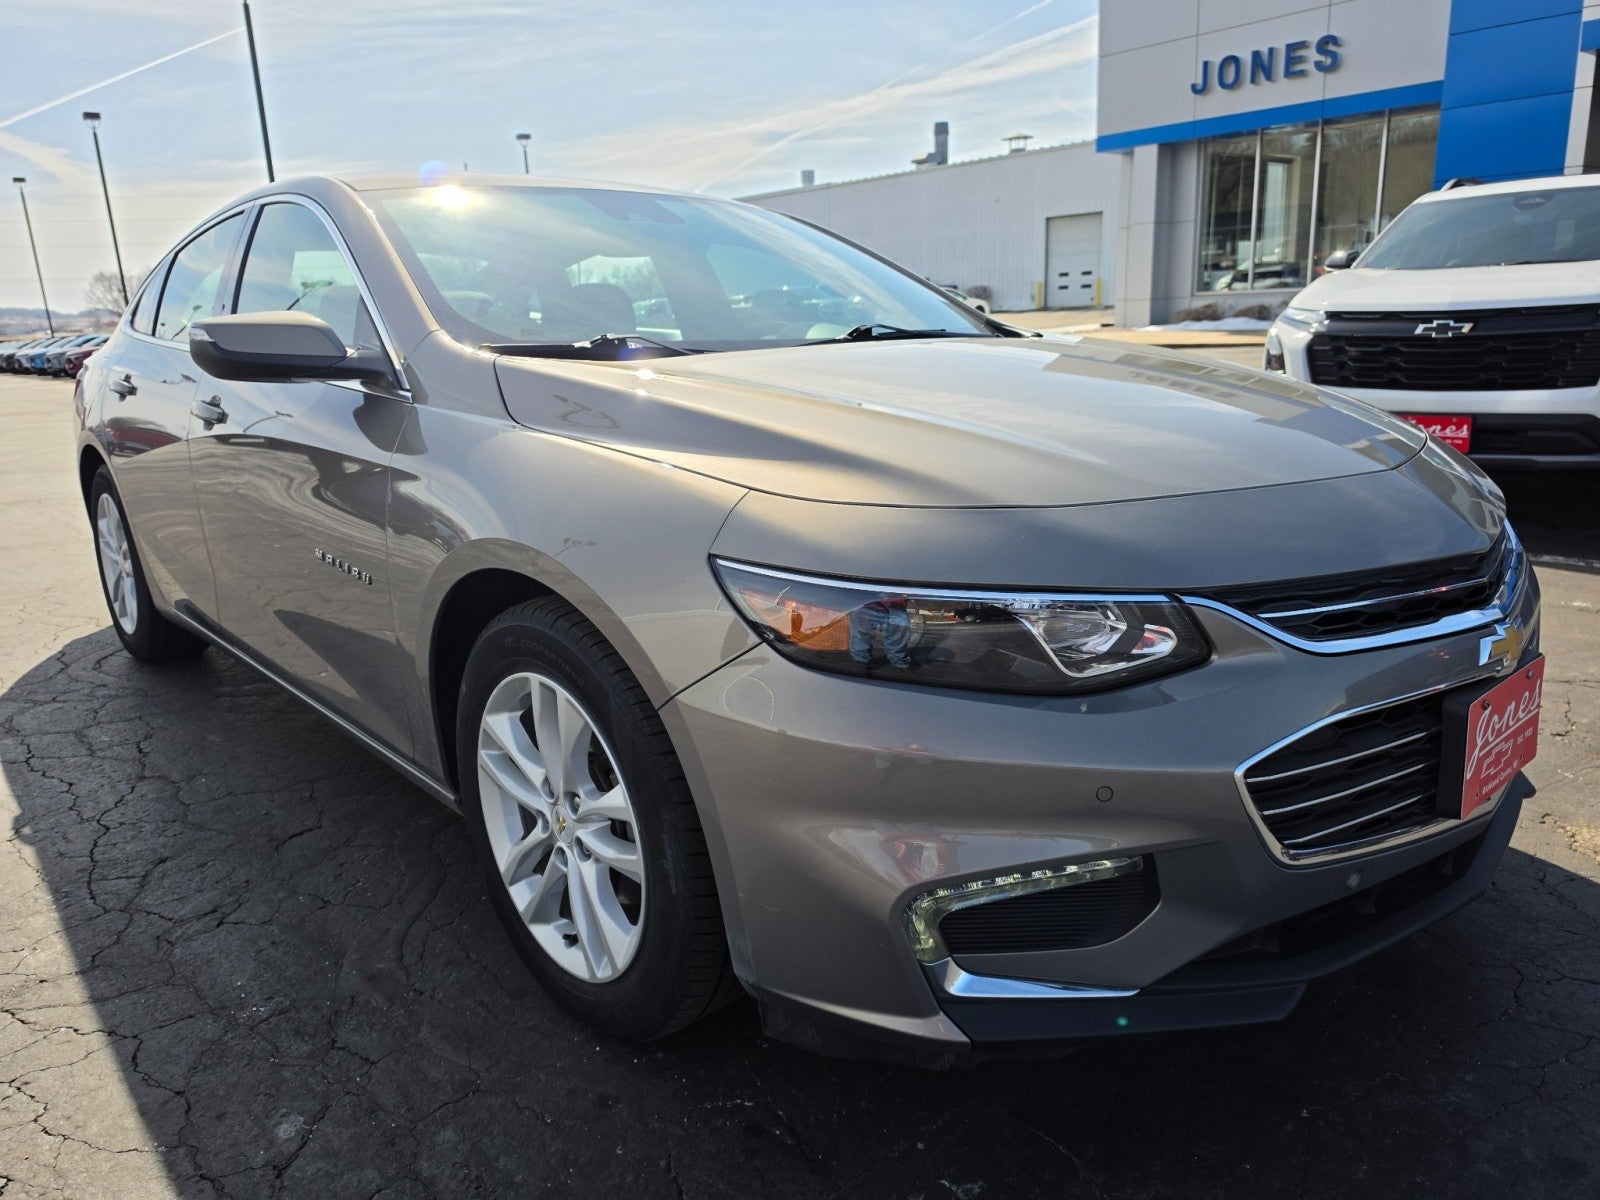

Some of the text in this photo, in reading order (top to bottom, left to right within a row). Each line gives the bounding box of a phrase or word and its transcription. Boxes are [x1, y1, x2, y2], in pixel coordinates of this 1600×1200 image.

[1190, 34, 1343, 96] JONES
[1410, 419, 1469, 437] nes
[315, 548, 373, 585] MALIBU
[1466, 678, 1541, 780] Jones
